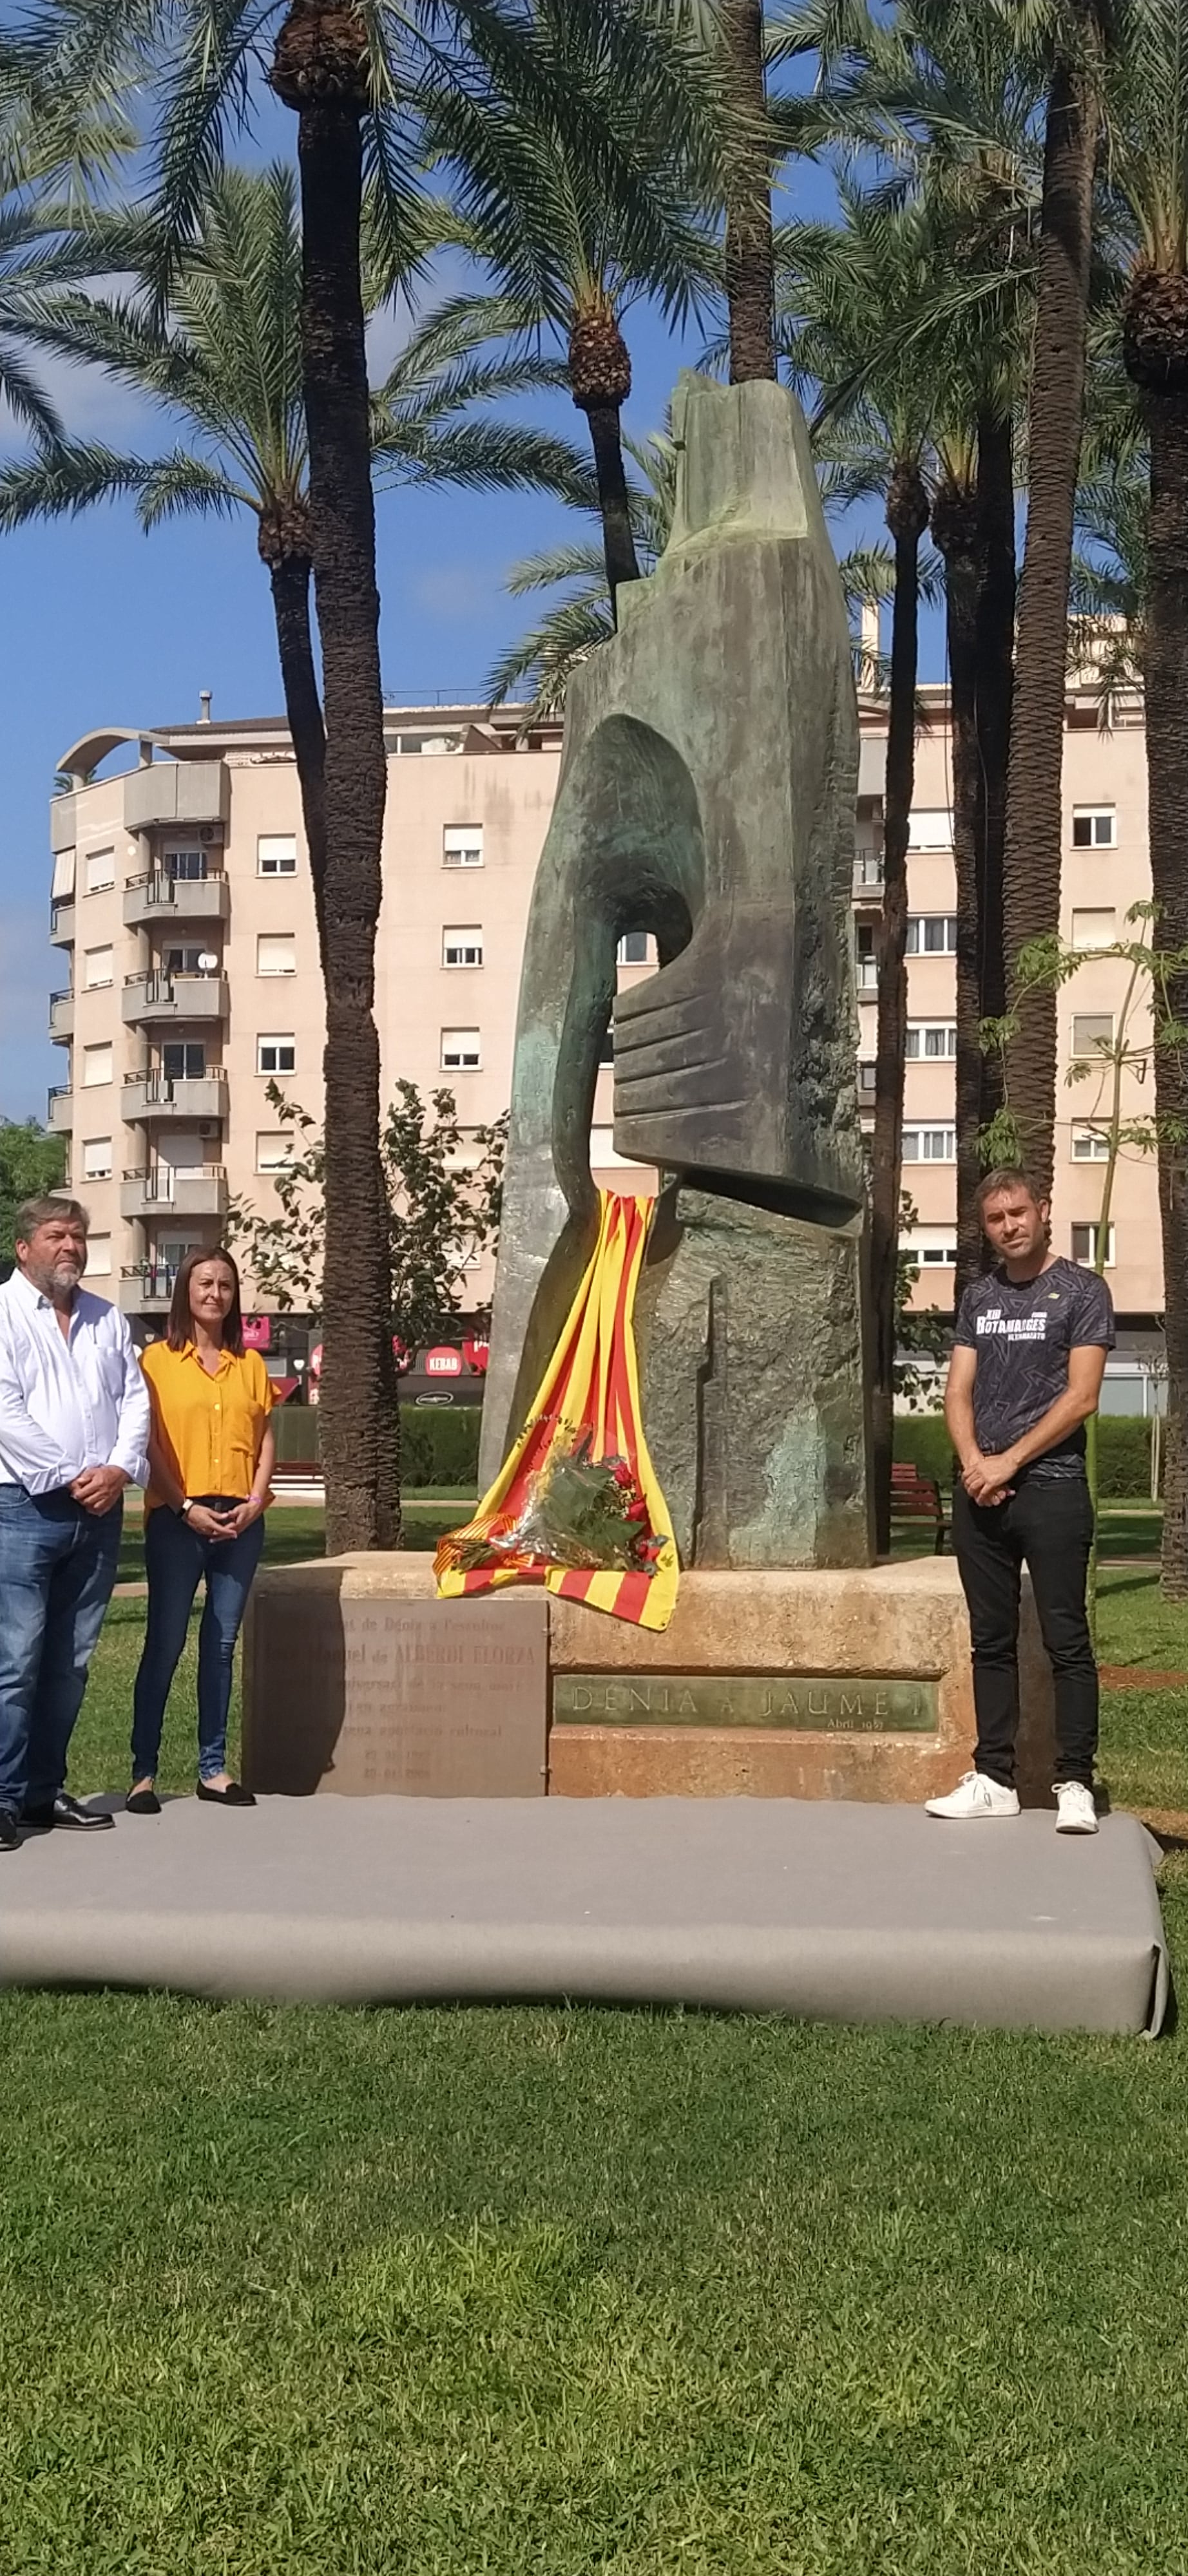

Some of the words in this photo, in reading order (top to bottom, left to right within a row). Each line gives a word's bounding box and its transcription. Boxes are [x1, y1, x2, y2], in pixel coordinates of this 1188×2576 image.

[429, 1357, 458, 1371] KEBAB
[362, 1617, 378, 1631] de
[372, 1649, 388, 1663] de
[396, 1643, 464, 1663] ALBERDI
[572, 1686, 698, 1713] DENIA
[758, 1690, 888, 1716] JAUME
[827, 1718, 854, 1729] Abril
